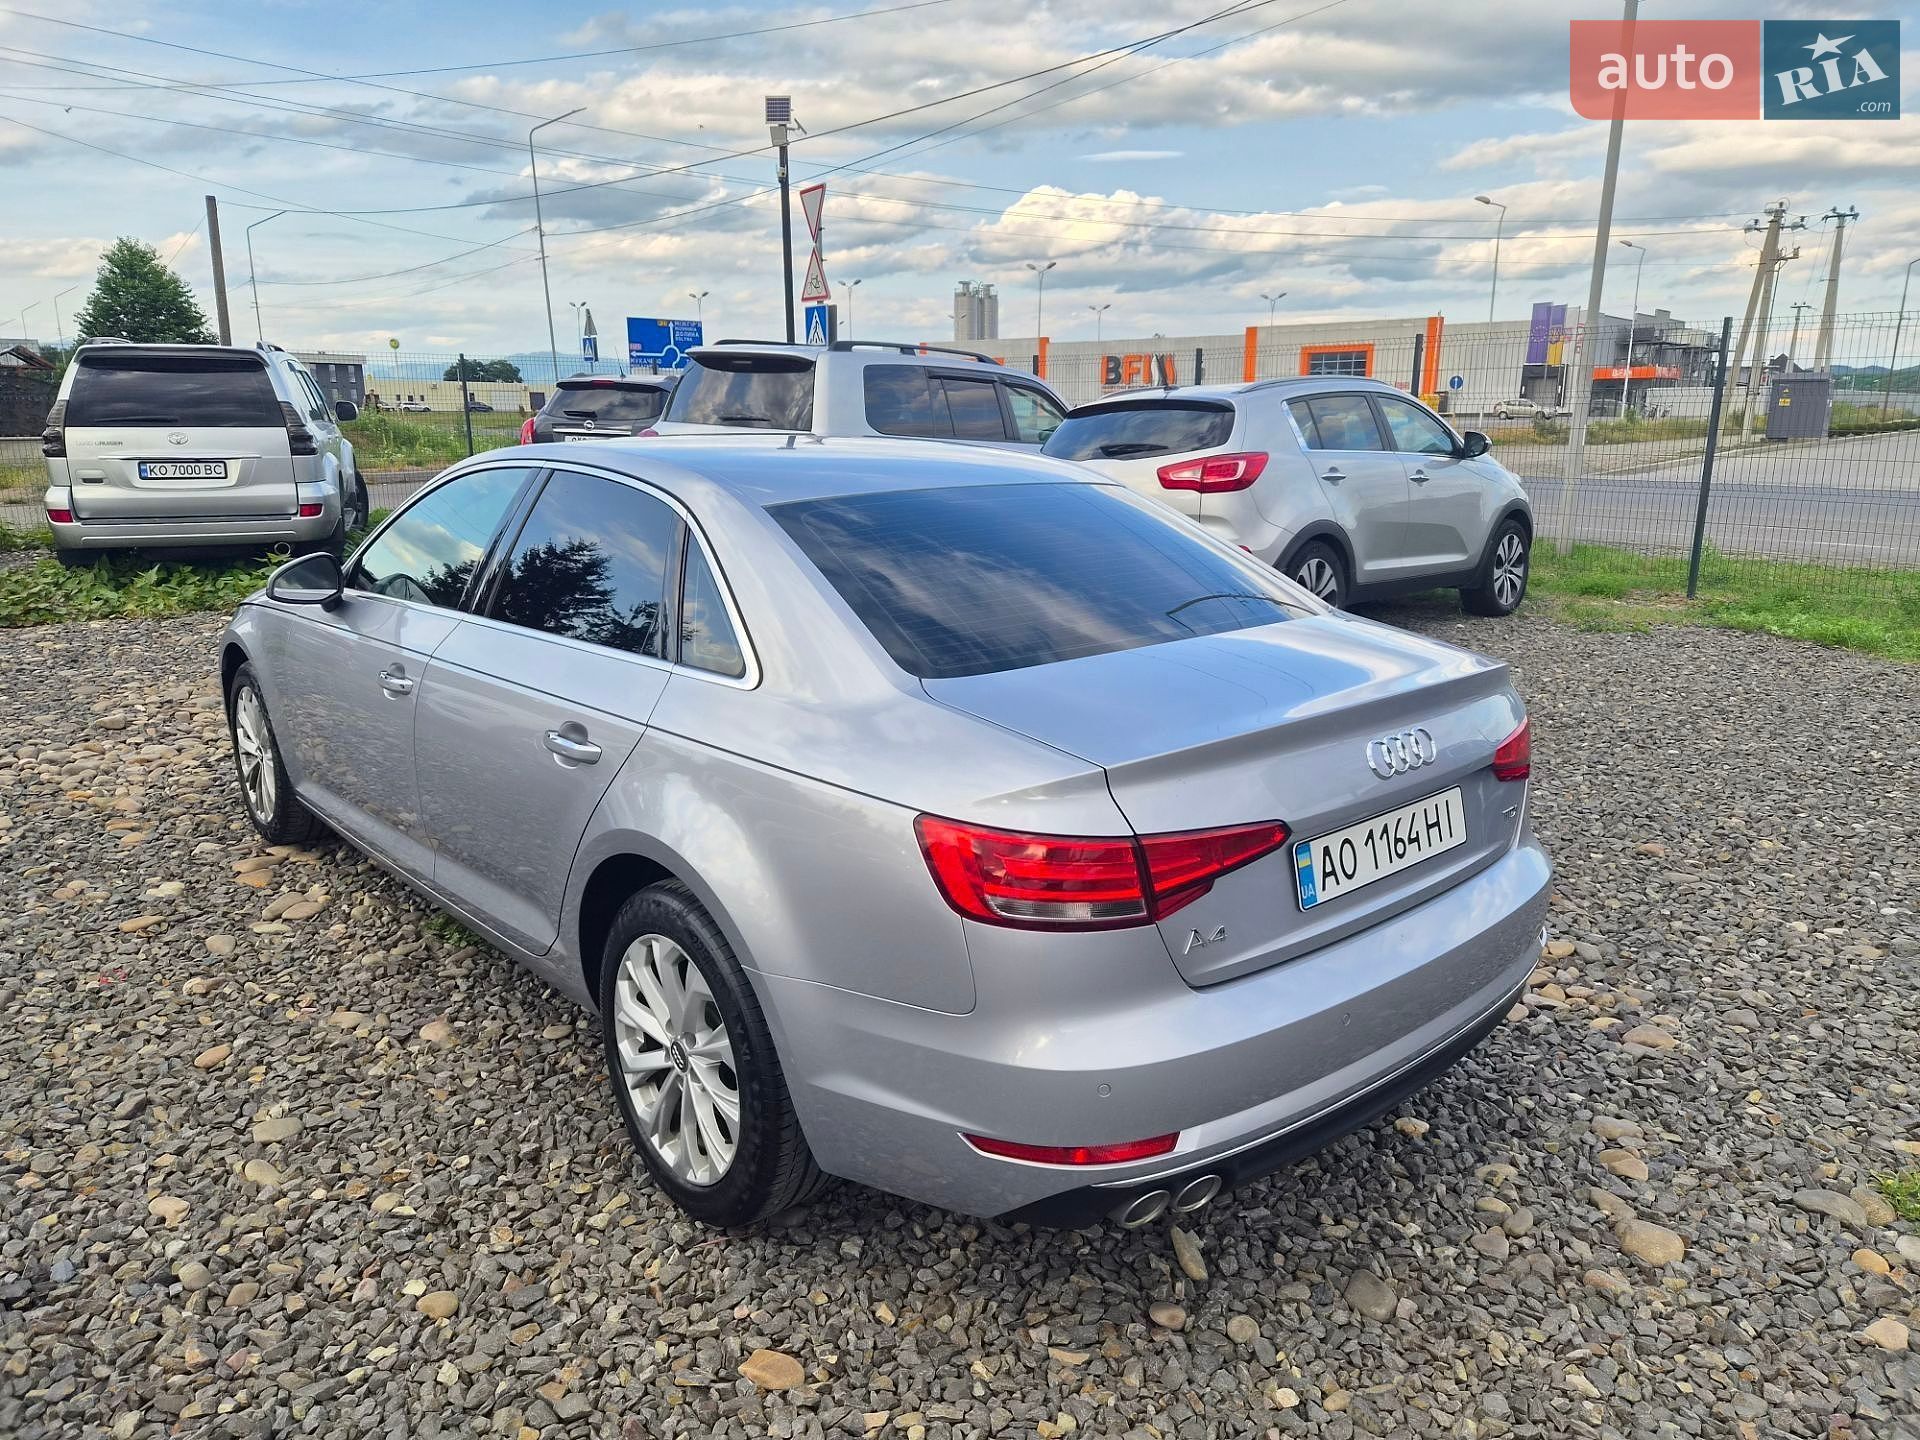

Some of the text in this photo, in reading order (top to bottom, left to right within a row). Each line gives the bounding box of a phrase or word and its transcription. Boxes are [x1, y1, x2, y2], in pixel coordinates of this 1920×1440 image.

[148, 464, 223, 476] KO 7000 BC
[1322, 799, 1453, 892] AO 1164 HI
[1301, 884, 1316, 899] UA
[1184, 925, 1228, 955] A4
